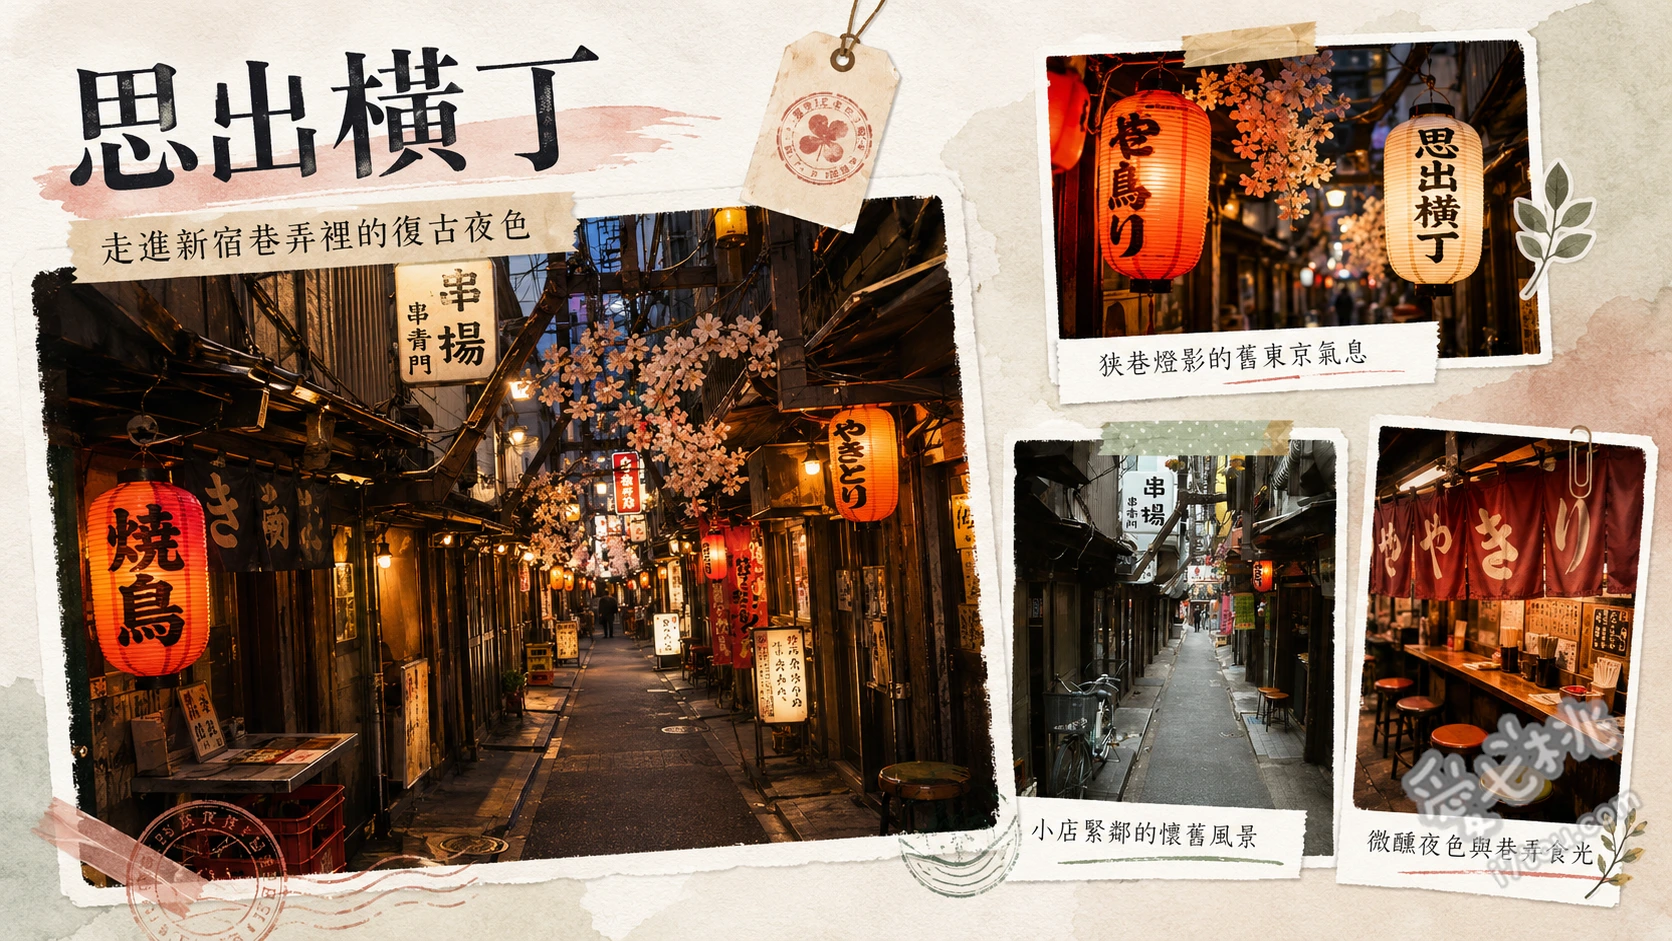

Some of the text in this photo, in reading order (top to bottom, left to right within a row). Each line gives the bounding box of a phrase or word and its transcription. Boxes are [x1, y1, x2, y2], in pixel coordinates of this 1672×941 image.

[437, 268, 486, 366] 串揚
[832, 418, 868, 510] やきとり
